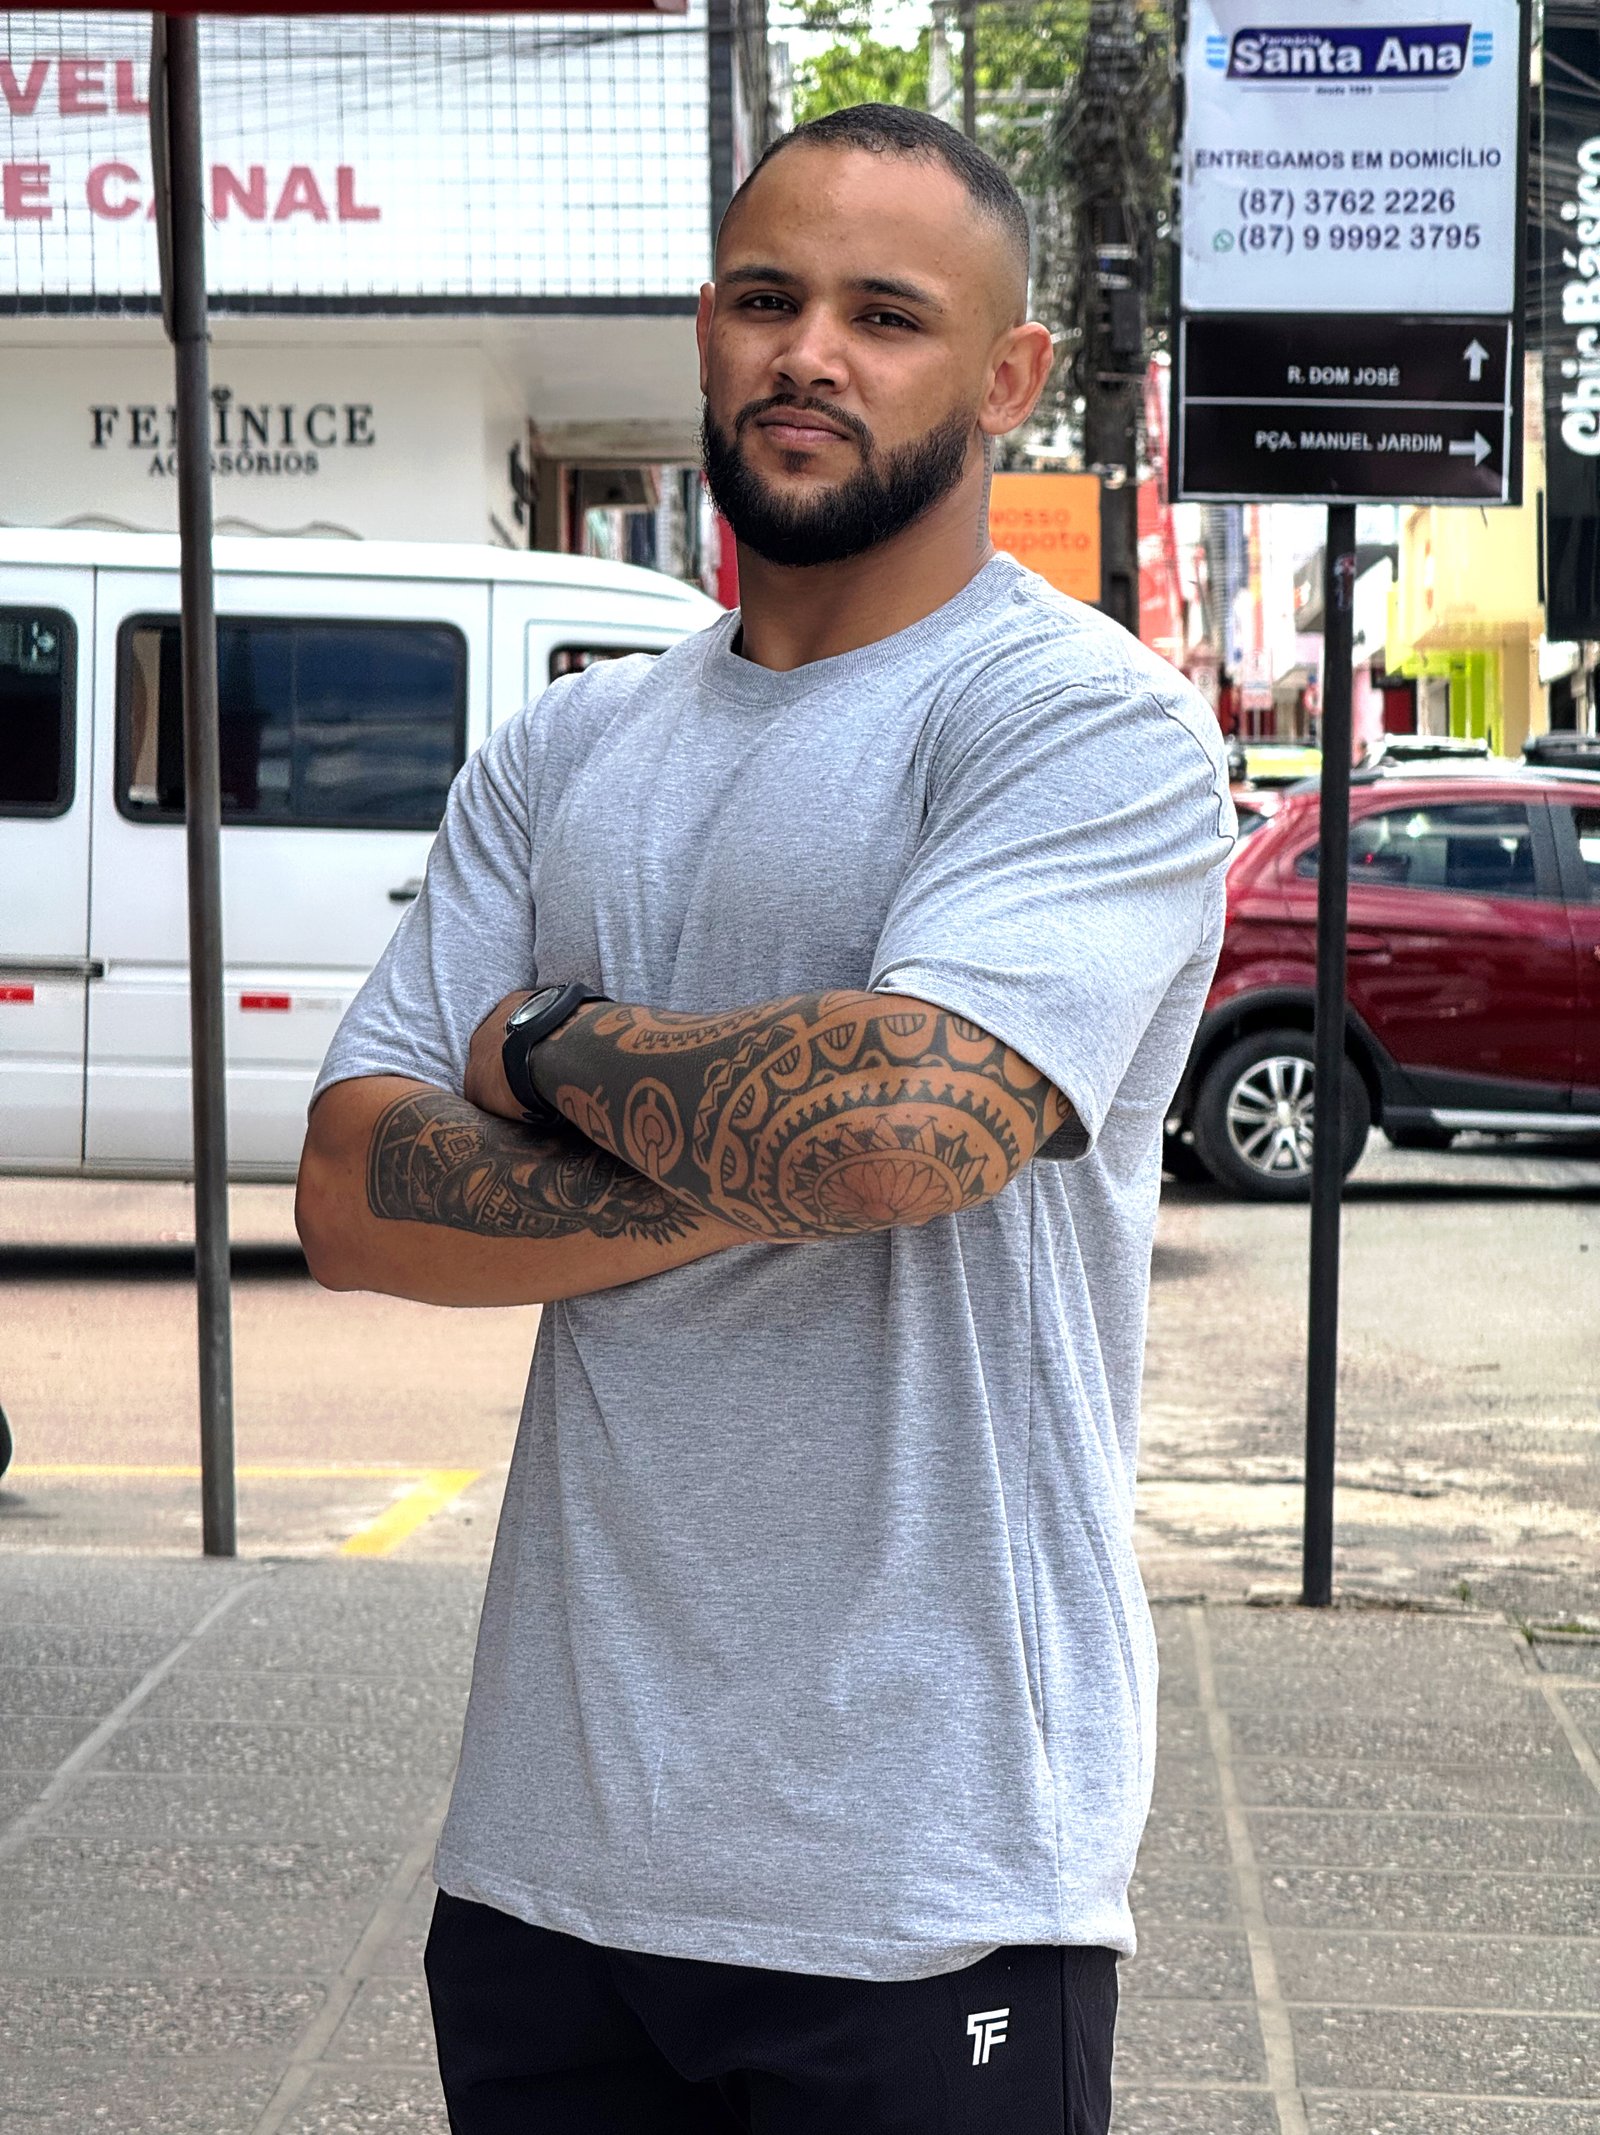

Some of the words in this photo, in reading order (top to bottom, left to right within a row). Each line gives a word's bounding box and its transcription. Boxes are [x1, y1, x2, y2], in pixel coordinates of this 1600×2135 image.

[1234, 37, 1362, 74] Santa
[1376, 37, 1462, 73] Ana
[1195, 149, 1345, 170] ENTREGAMOS
[1352, 150, 1383, 169] EM
[1390, 147, 1502, 169] DOMICÍLIO
[86, 162, 381, 221] CNAL
[1239, 188, 1295, 219] (87)
[1304, 189, 1375, 215] 3762
[1385, 188, 1455, 214] 2226
[1239, 224, 1295, 255] (87)
[1303, 225, 1320, 250] 9
[1329, 225, 1401, 250] 9992
[1410, 224, 1480, 250] 3795
[1561, 136, 1600, 324] Básico
[1287, 366, 1306, 384] R.
[1309, 367, 1350, 385] DOM
[1353, 364, 1400, 387] JOSÉ
[1561, 325, 1600, 456] Chic
[89, 400, 376, 449] FEINICE
[1255, 430, 1297, 452] PÇA.
[1300, 431, 1374, 451] MANUEL
[1377, 433, 1443, 453] JARDIM
